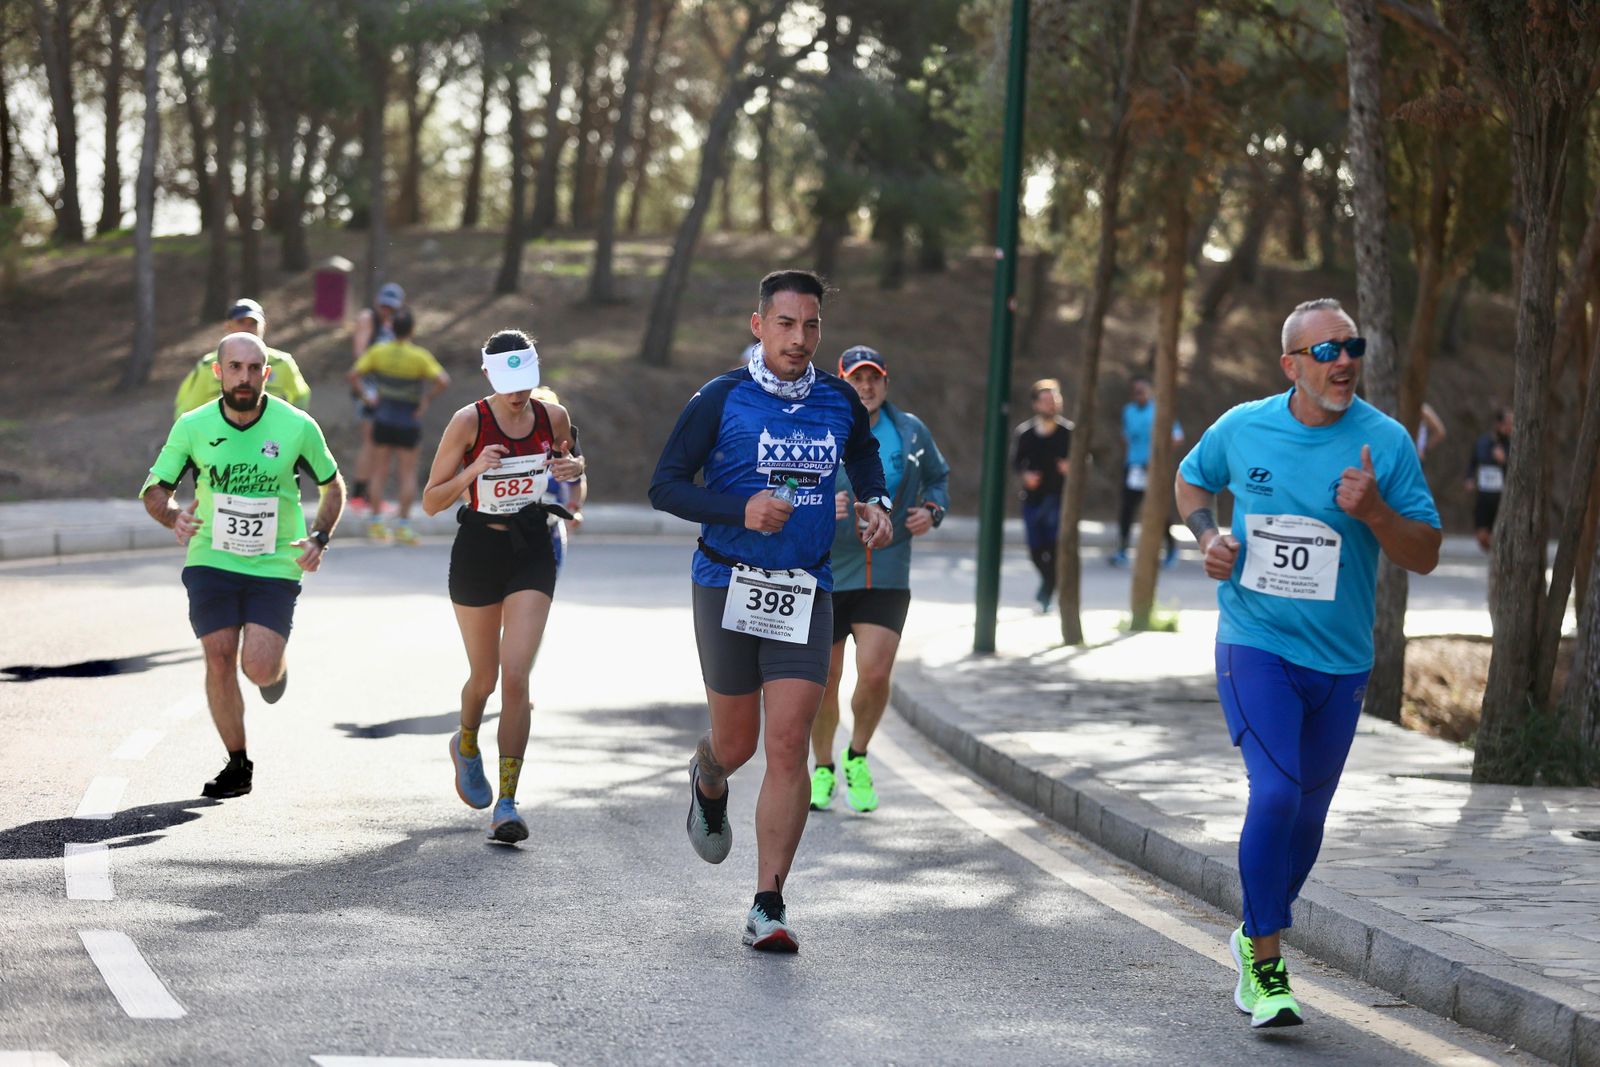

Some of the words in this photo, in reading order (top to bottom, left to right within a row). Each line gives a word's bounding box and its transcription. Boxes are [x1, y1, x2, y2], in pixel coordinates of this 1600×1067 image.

[762, 444, 834, 462] XXXIX
[798, 462, 833, 470] POPULAR
[494, 478, 533, 498] 682
[226, 517, 263, 537] 332
[1273, 544, 1309, 571] 50
[746, 588, 795, 616] 398
